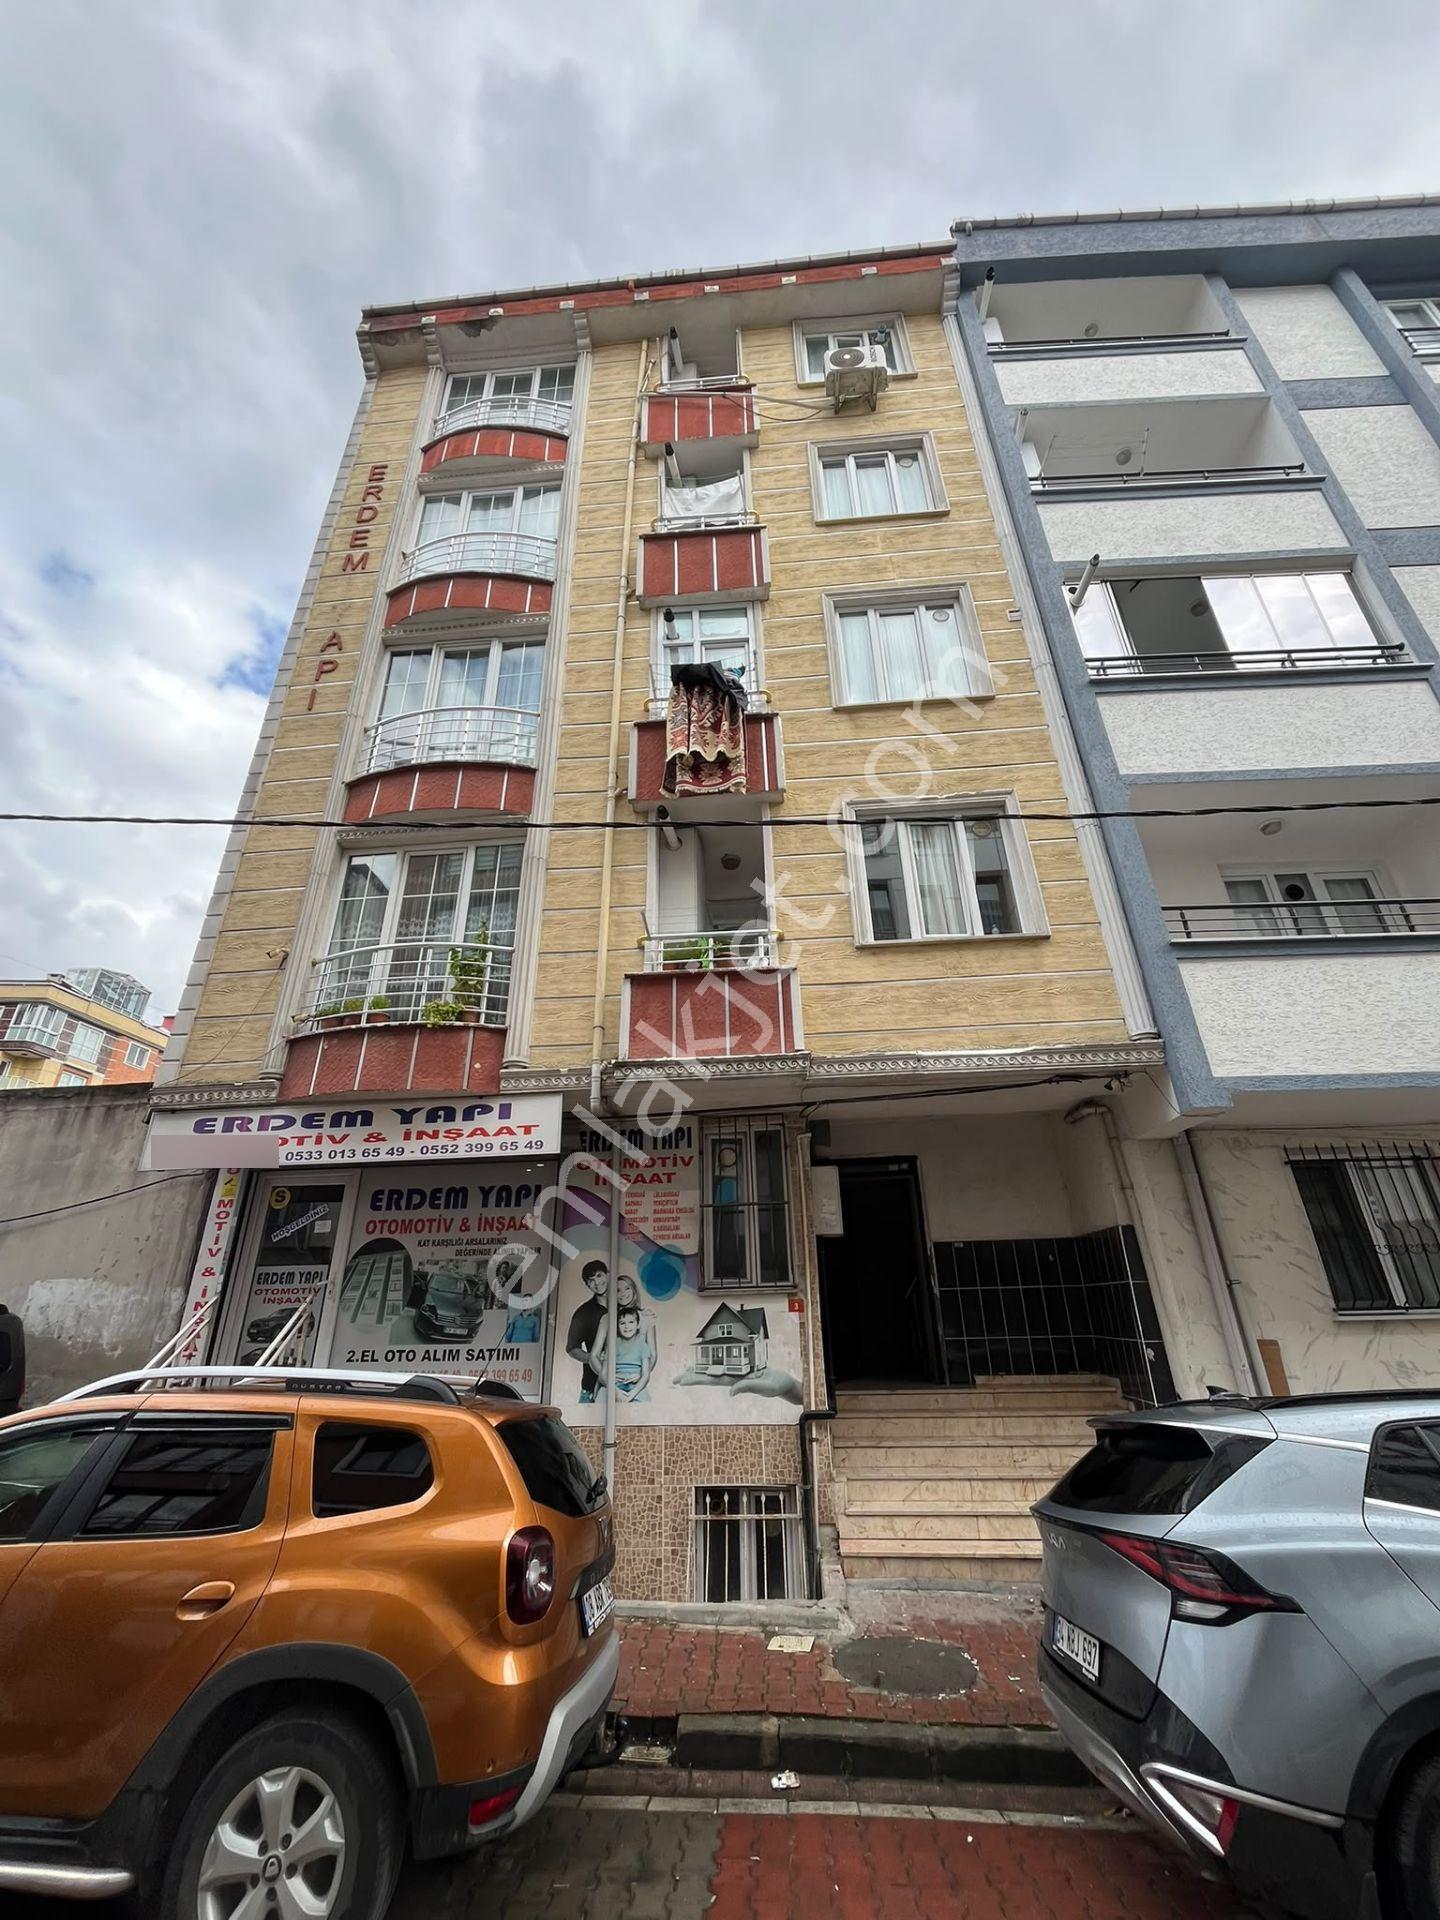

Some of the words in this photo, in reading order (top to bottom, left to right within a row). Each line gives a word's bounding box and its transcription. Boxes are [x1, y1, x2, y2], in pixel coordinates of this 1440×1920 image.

[342, 464, 388, 572] ERDEM
[192, 1109, 374, 1134] ERDEM
[391, 1103, 512, 1126] YAPI
[363, 1132, 388, 1143] &
[403, 1125, 540, 1142] İNŞAAT
[285, 1150, 323, 1161] 0533
[328, 1149, 356, 1160] 013
[361, 1148, 381, 1158] 65
[385, 1147, 405, 1157] 49
[420, 1144, 459, 1155] 0552
[465, 1142, 494, 1153] 399
[499, 1141, 519, 1151] 65
[524, 1140, 544, 1150] 49
[369, 1186, 468, 1211] ERDEM
[478, 1184, 542, 1208] YAPI
[365, 1214, 455, 1235] OTOMOTİV
[459, 1216, 470, 1232] &
[256, 1271, 295, 1285] ERDEM
[299, 1271, 324, 1285] YAPI
[346, 1350, 379, 1363] 2.EL
[384, 1349, 417, 1362] OTO
[421, 1348, 460, 1362] ALIM
[465, 1347, 520, 1361] SATIMI
[522, 1368, 533, 1382] 49
